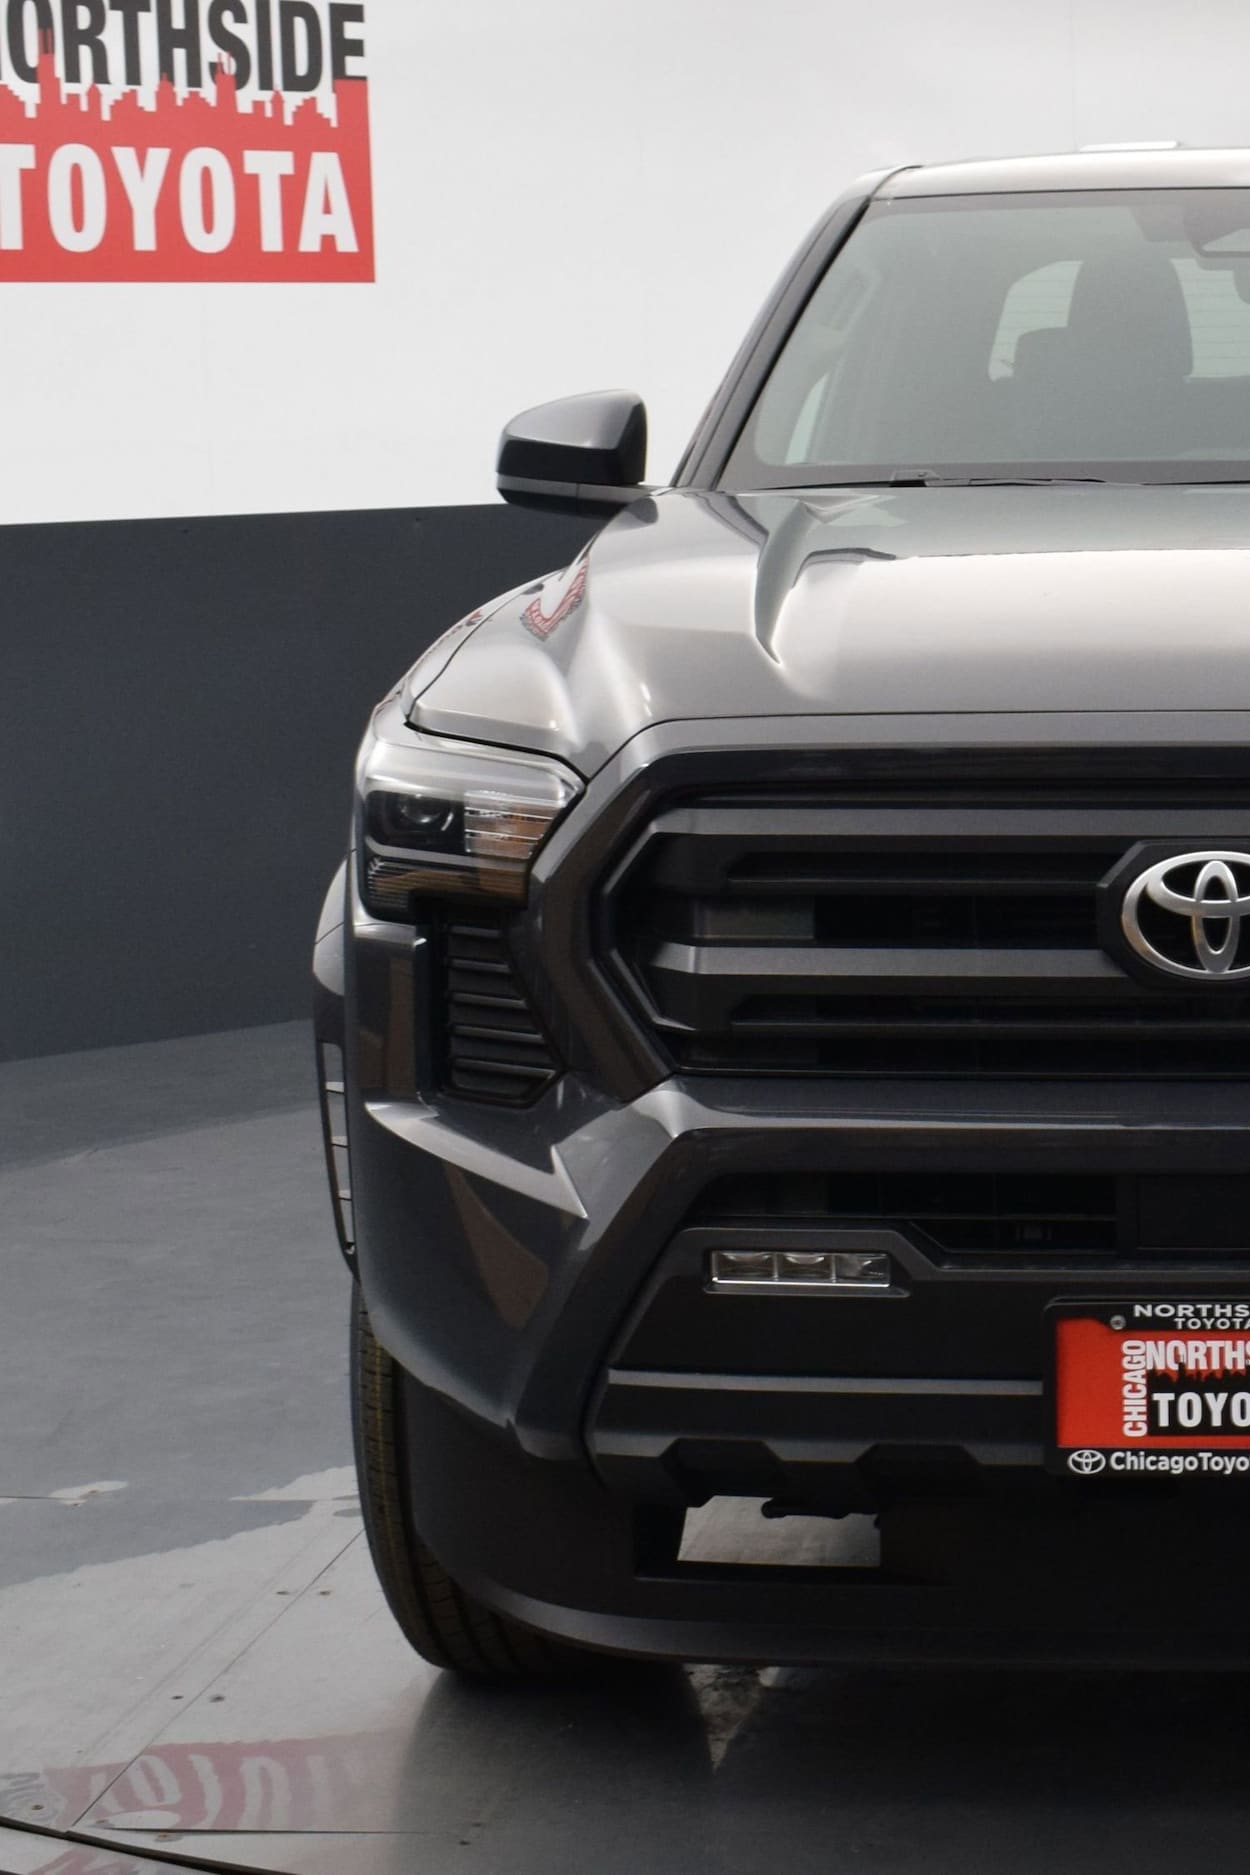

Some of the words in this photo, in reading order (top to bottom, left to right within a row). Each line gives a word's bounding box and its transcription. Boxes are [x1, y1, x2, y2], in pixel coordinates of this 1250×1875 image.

[0, 0, 367, 93] ORTHSIDE
[0, 142, 359, 254] TOYOTA
[1121, 1339, 1148, 1437] CHICAGO
